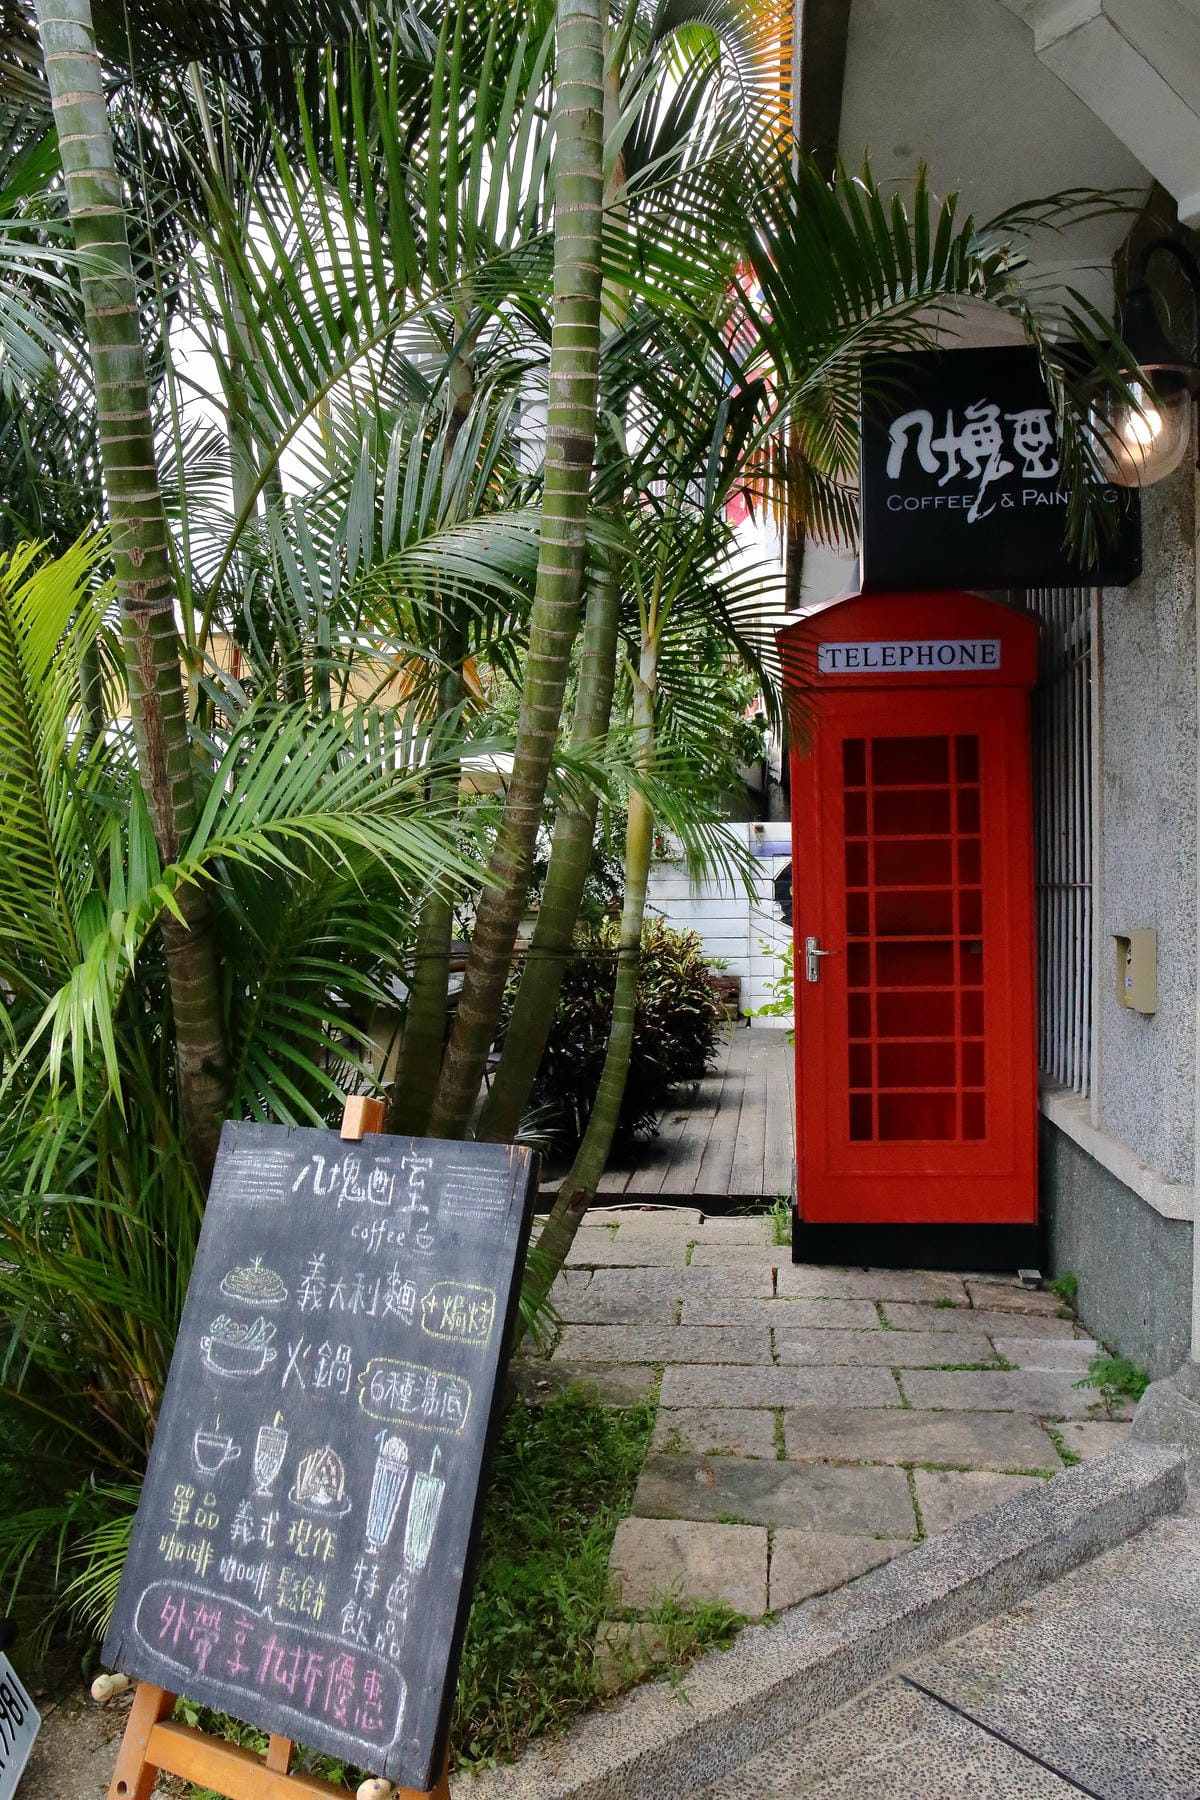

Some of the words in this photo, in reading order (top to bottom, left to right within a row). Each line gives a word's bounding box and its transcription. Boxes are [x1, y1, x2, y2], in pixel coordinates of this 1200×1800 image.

[886, 494, 974, 512] COFFEE
[1001, 493, 1016, 508] &
[826, 643, 997, 669] TELEPHONE
[351, 1219, 406, 1256] coffee
[281, 1332, 353, 1395] 火鍋
[230, 1497, 281, 1549] 義式
[158, 1531, 215, 1579] 咖啡
[219, 1555, 271, 1602] 咖啡
